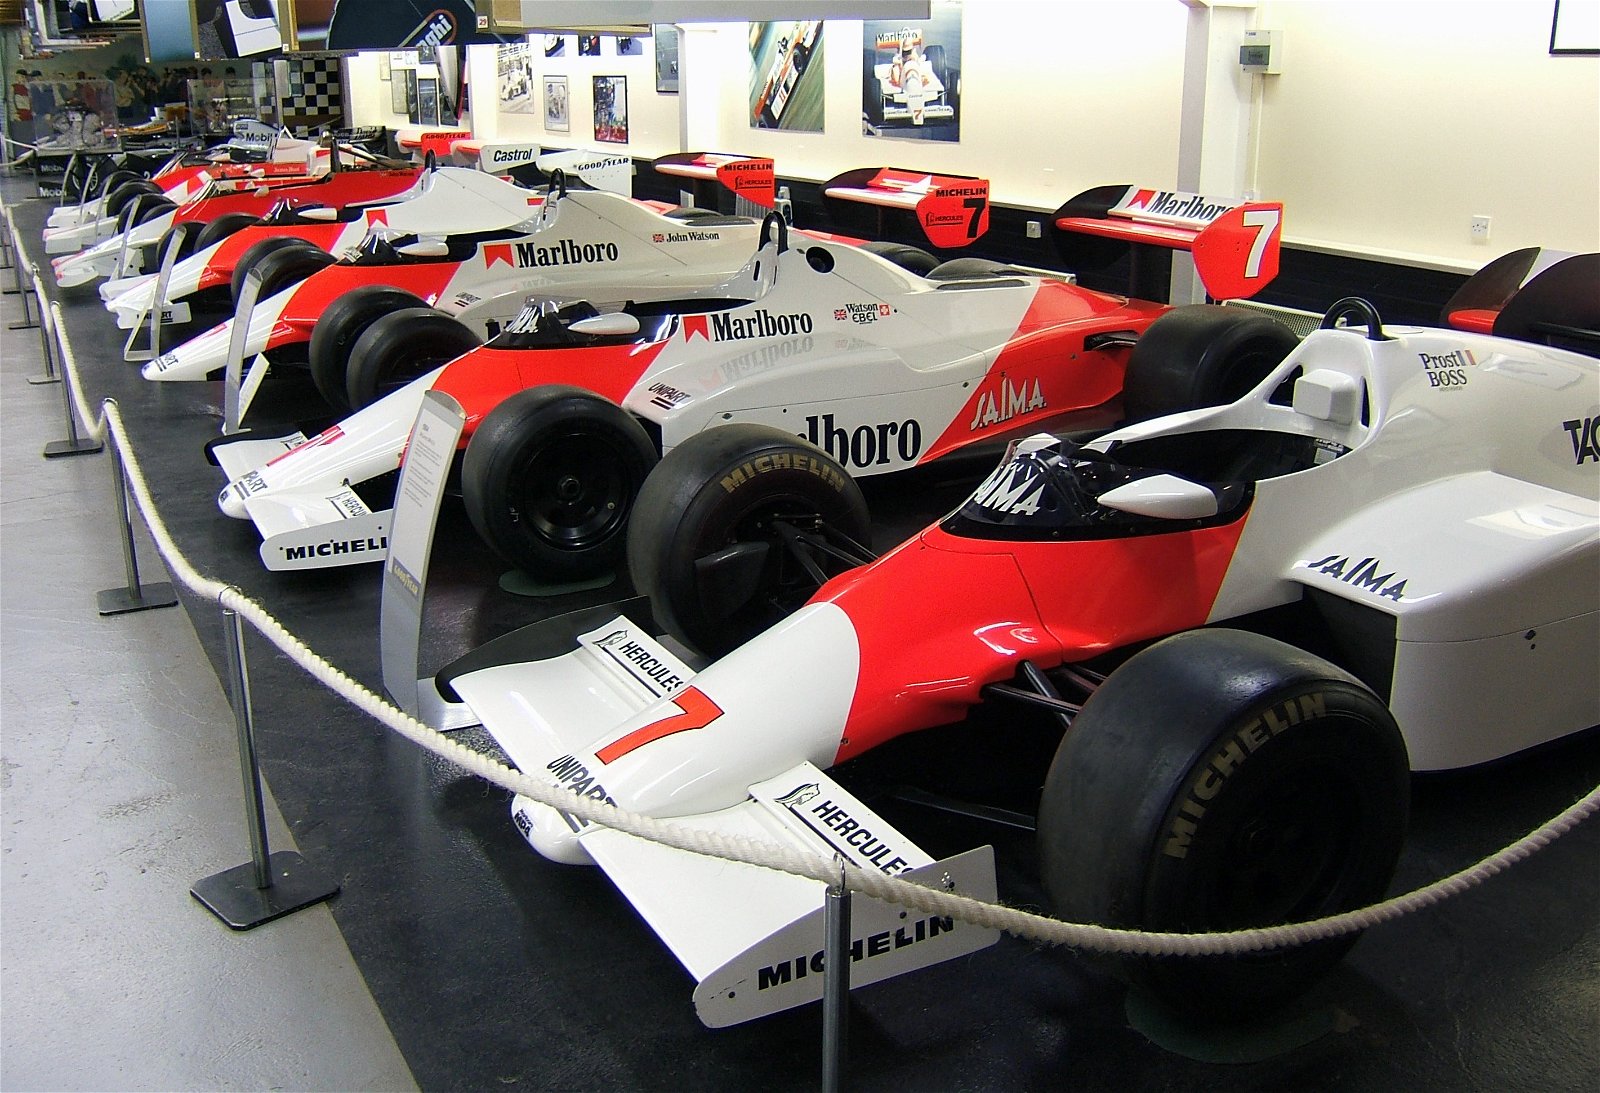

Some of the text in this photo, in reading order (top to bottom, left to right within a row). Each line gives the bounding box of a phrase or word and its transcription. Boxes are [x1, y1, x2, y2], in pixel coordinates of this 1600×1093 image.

[913, 109, 922, 120] 7
[493, 149, 533, 162] Castrol
[577, 156, 630, 171] GOODYEAR
[724, 163, 773, 171] MICHELIN
[40, 186, 67, 198] Mobl
[935, 187, 987, 198] MICHELIN
[963, 197, 986, 239] 7
[666, 231, 720, 242] John Watson
[1242, 208, 1281, 279] 7
[515, 239, 619, 268] Marlboro
[845, 303, 879, 313] Watson
[711, 310, 813, 342] Marlboro
[1418, 351, 1460, 369] Prost
[1427, 369, 1467, 387] BOSS
[648, 382, 691, 404] UNIPART
[719, 451, 846, 493] MICHELIN
[286, 536, 388, 560] MICHELI
[594, 684, 725, 766] 7
[1163, 692, 1327, 859] MICHELIN
